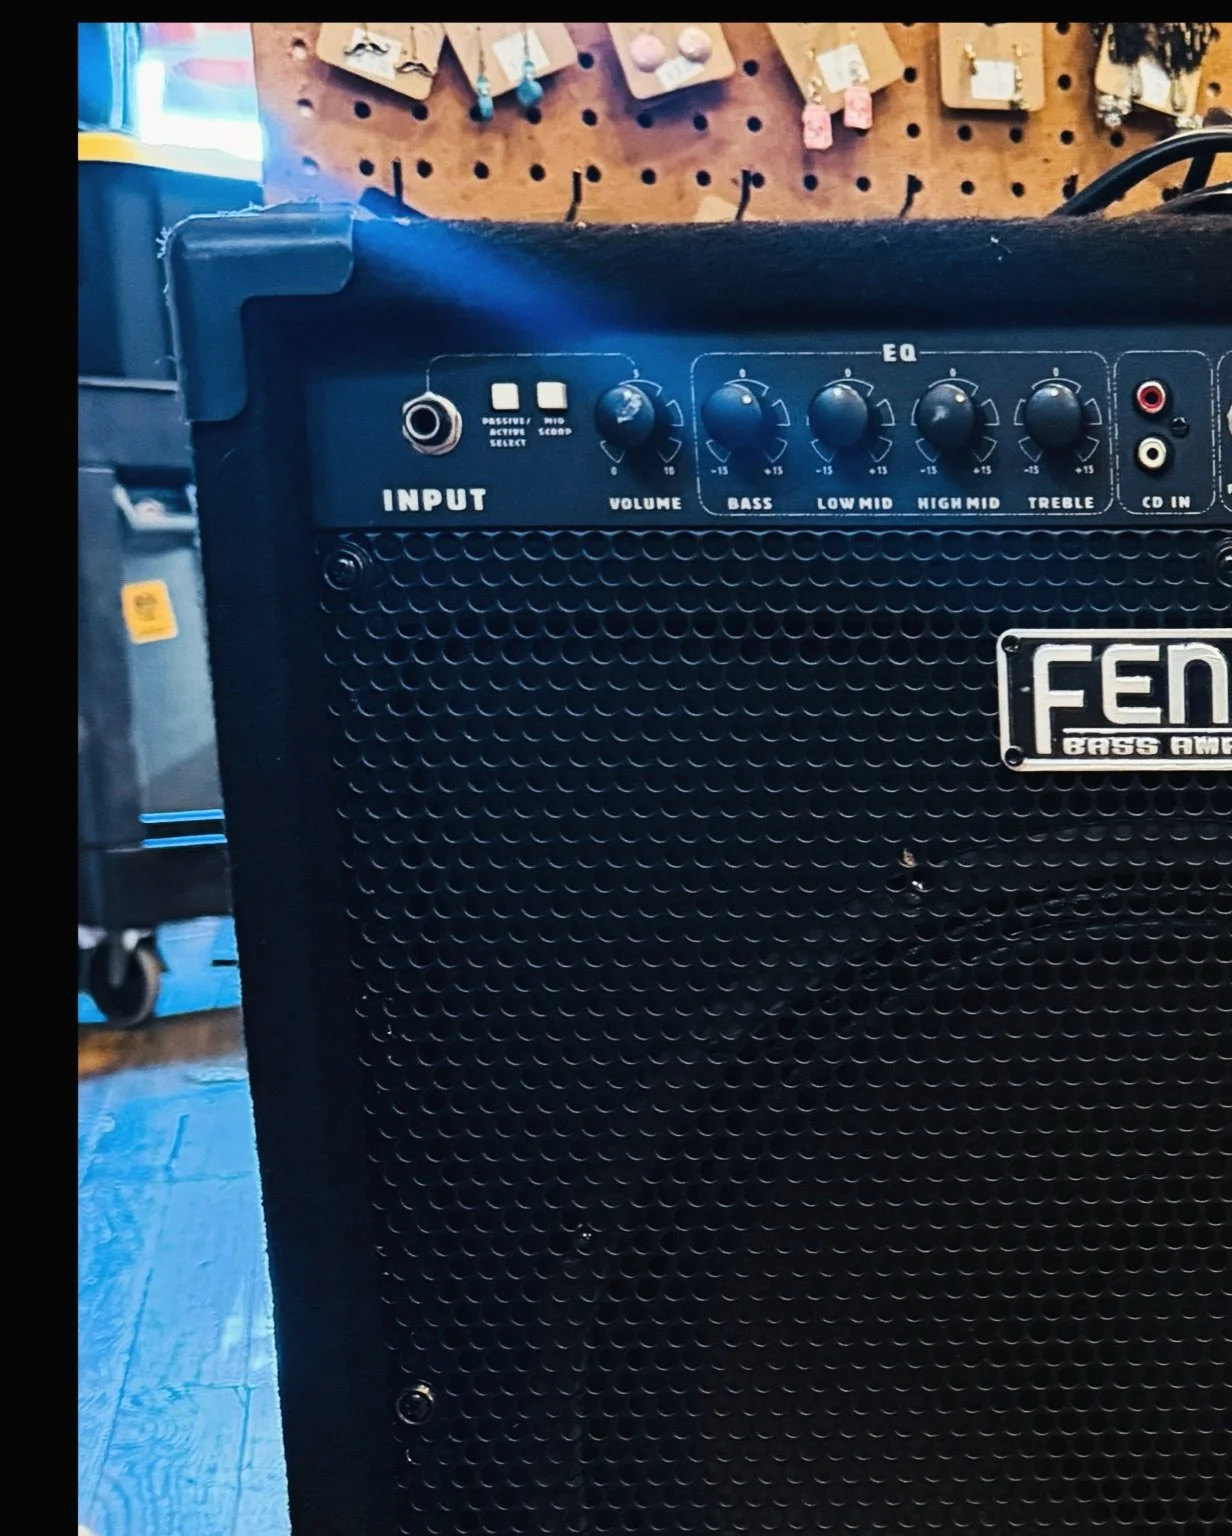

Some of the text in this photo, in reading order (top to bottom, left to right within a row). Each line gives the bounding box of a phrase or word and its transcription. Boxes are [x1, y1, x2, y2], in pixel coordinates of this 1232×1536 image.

[883, 343, 917, 362] EQ
[633, 369, 640, 378] 5
[481, 417, 531, 425] PASSIVE/
[543, 417, 565, 425] MID
[489, 428, 525, 436] ACTIVE
[538, 427, 572, 436] SCOOP
[490, 439, 526, 447] SELECT
[383, 488, 487, 511] INPUT
[609, 497, 682, 510] VOLUME
[727, 497, 773, 510] BASS
[817, 497, 893, 510] LOW MID
[918, 497, 1000, 510] HIGH MID
[1028, 496, 1094, 510] TREBLE
[1142, 496, 1191, 509] CD IN
[1063, 735, 1160, 756] BASS
